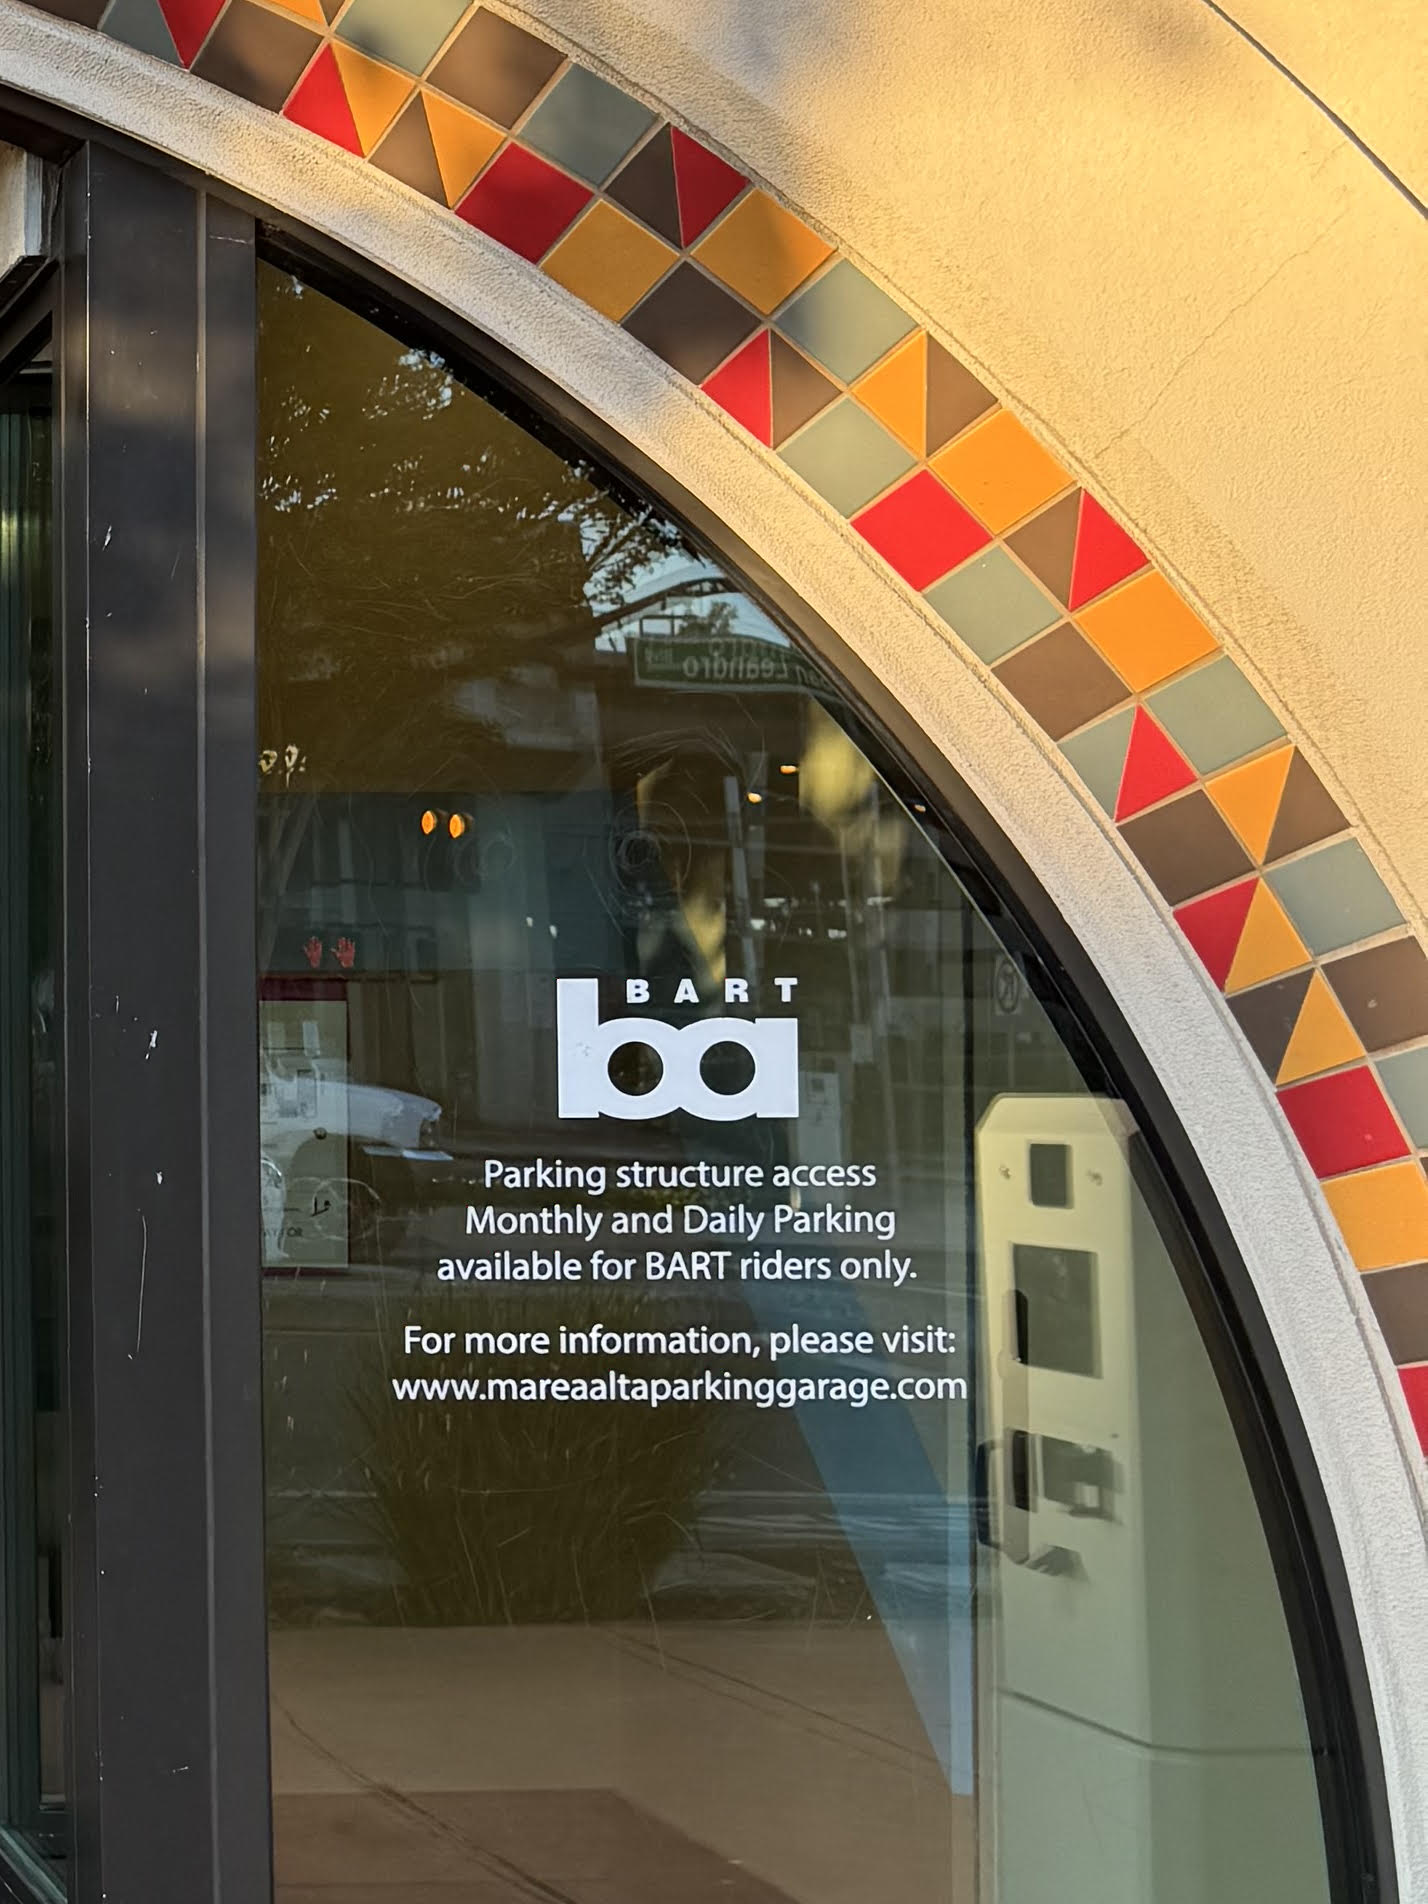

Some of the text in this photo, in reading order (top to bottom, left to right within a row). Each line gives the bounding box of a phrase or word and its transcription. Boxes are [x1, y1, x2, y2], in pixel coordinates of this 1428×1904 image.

[626, 978, 799, 1004] BART
[485, 1158, 877, 1196] Parking structure access
[466, 1202, 896, 1242] Monthly and Daily Parking
[437, 1249, 917, 1287] available for BART riders only.
[404, 1323, 956, 1361] For more information, please visit:
[392, 1370, 967, 1408] www.mareaaltaparkinggarage.com
